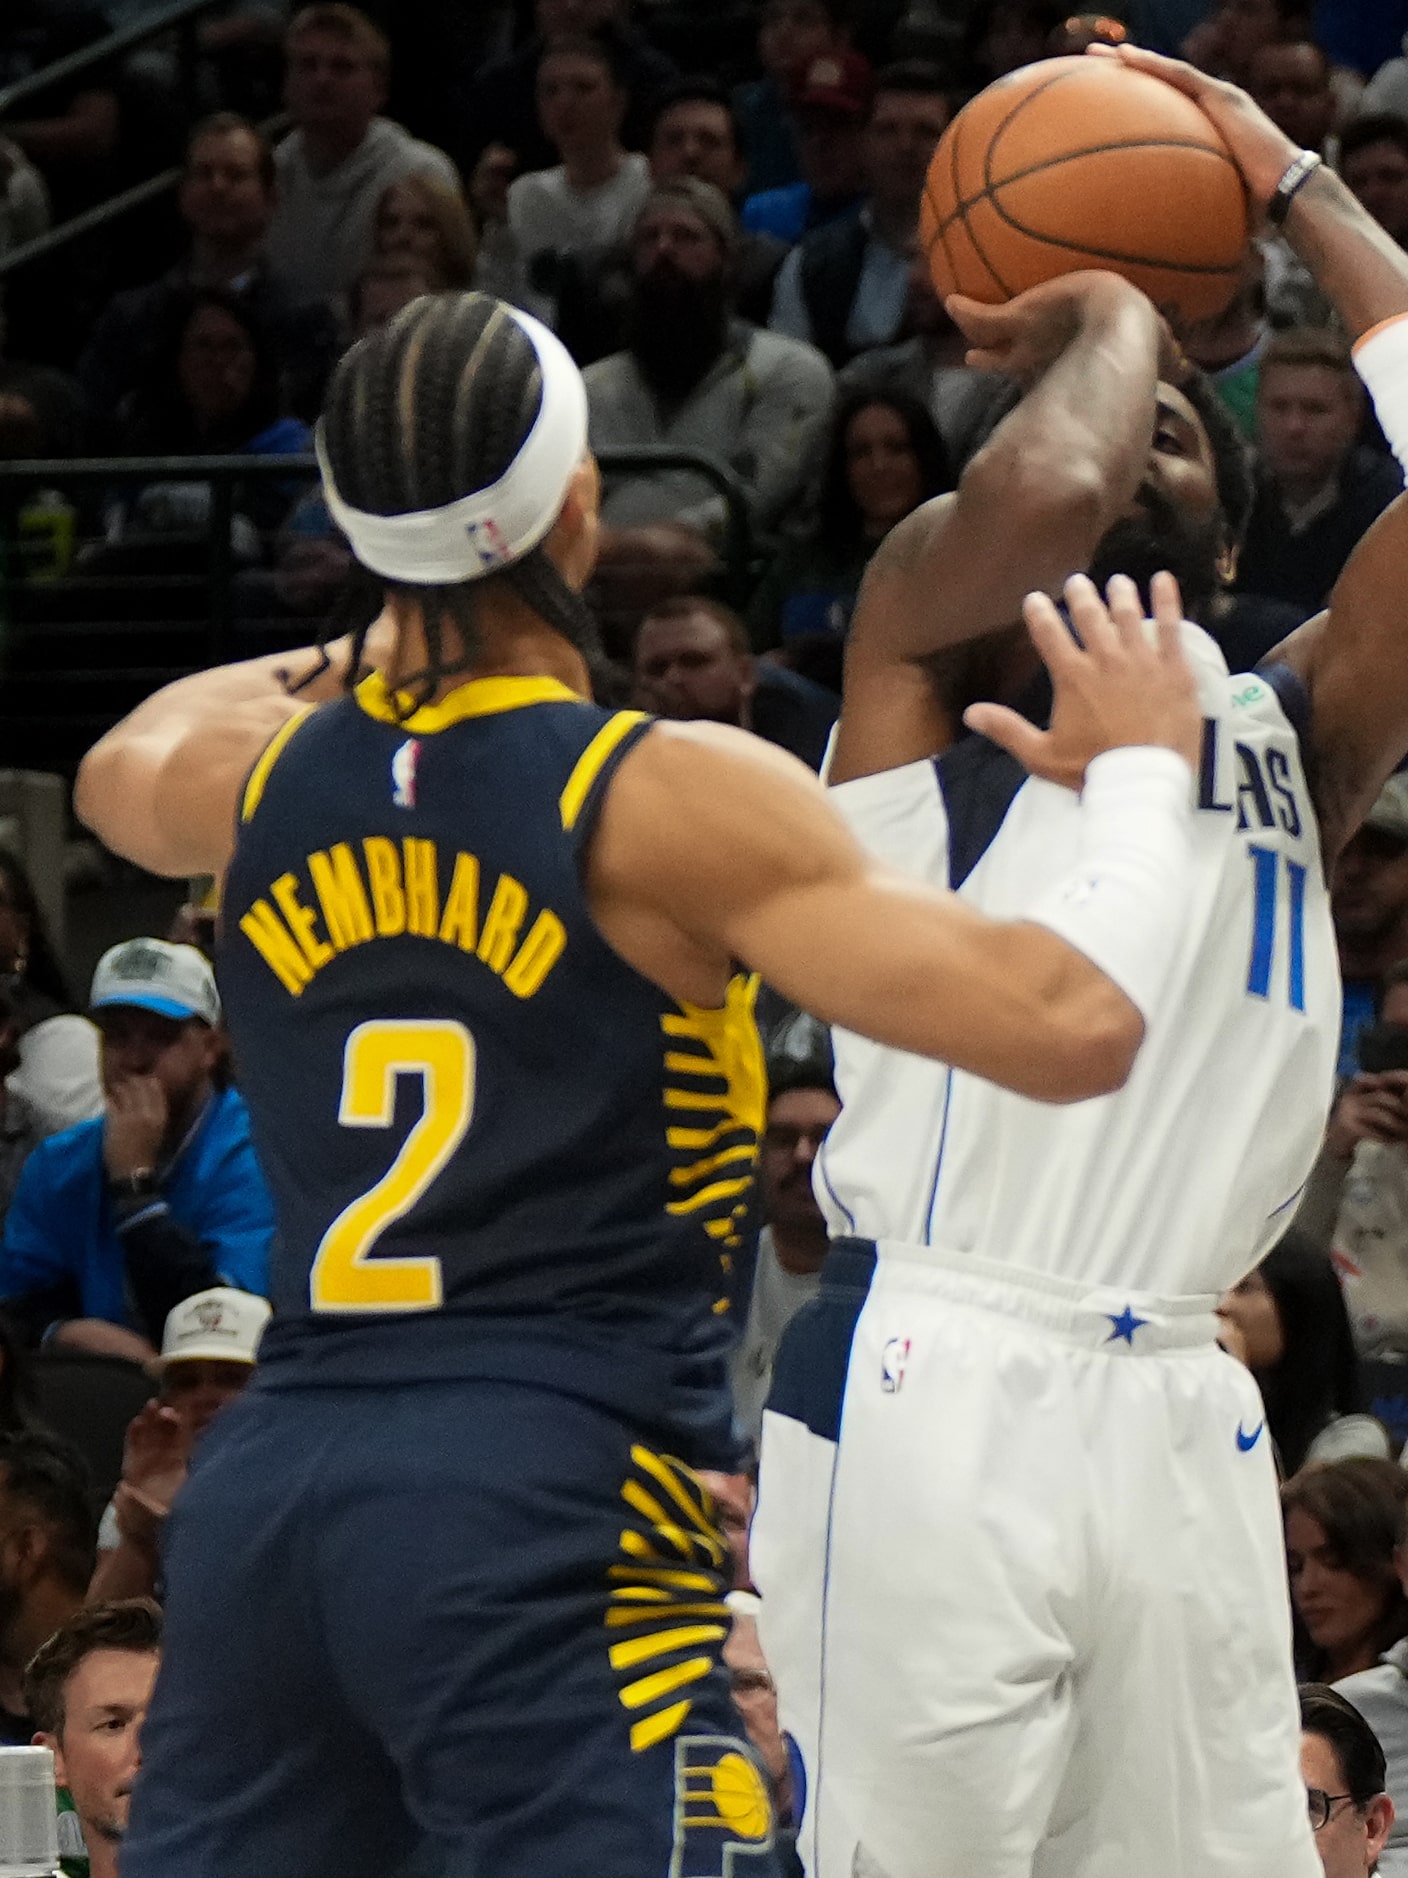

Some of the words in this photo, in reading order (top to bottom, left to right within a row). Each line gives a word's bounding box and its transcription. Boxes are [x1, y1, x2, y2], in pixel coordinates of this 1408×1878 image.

[239, 834, 568, 1001] NEMBHARD
[1247, 843, 1307, 1014] 11
[310, 1018, 478, 1316] 2
